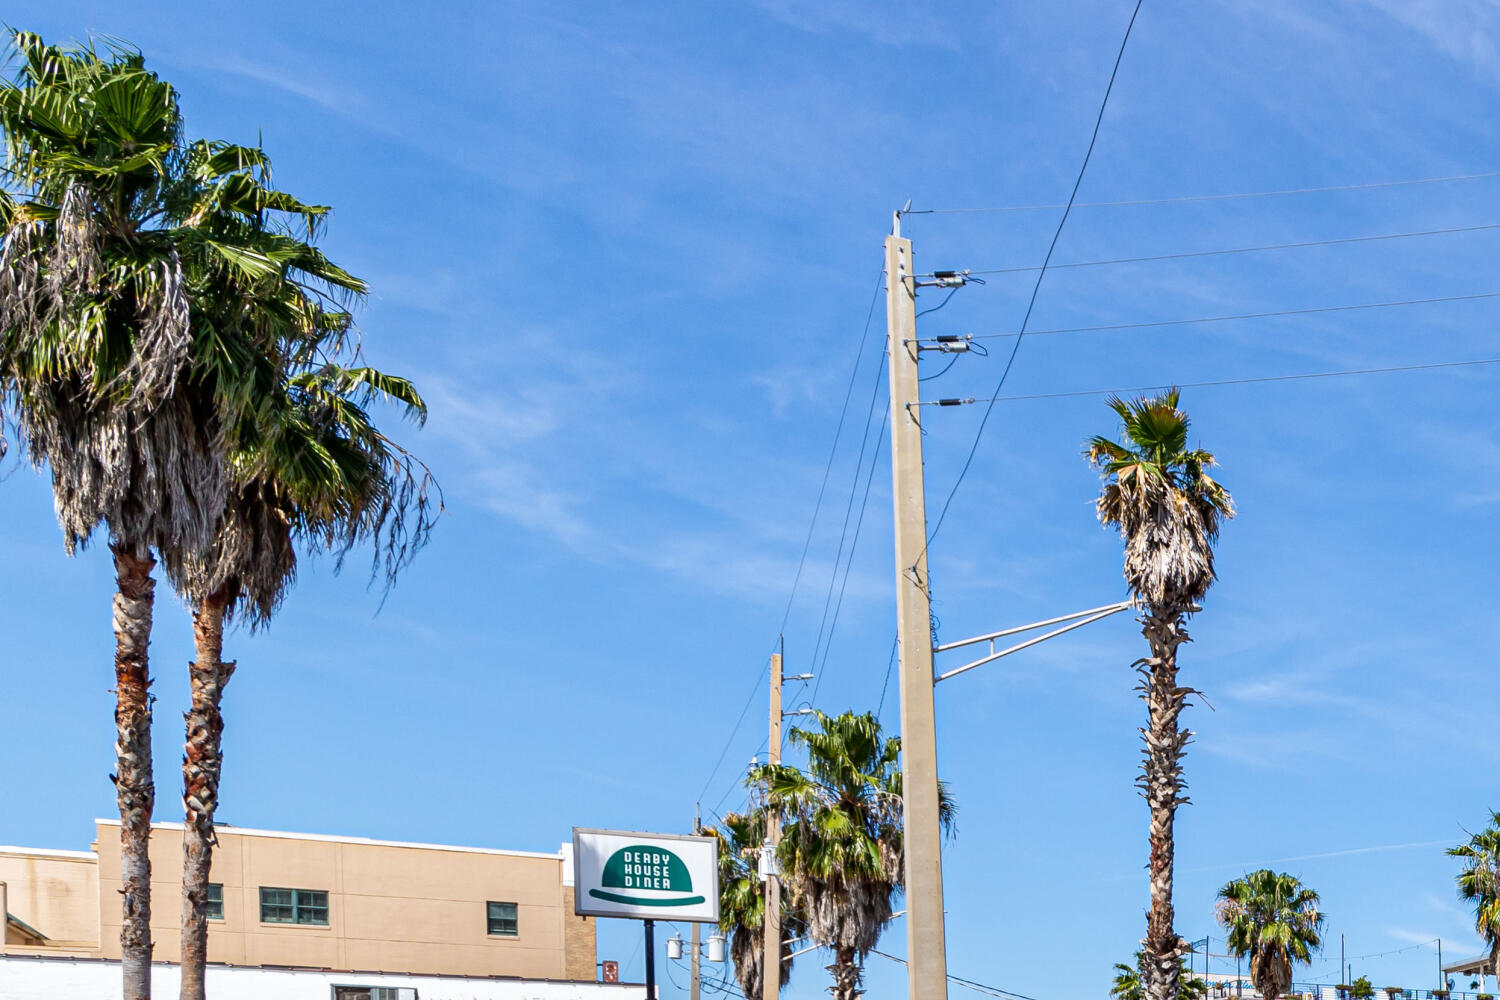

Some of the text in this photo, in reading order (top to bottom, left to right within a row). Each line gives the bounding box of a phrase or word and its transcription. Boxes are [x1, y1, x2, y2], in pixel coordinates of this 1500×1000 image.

[624, 851, 670, 865] DERBY
[624, 864, 670, 878] HOUSE
[624, 876, 671, 889] DINER
